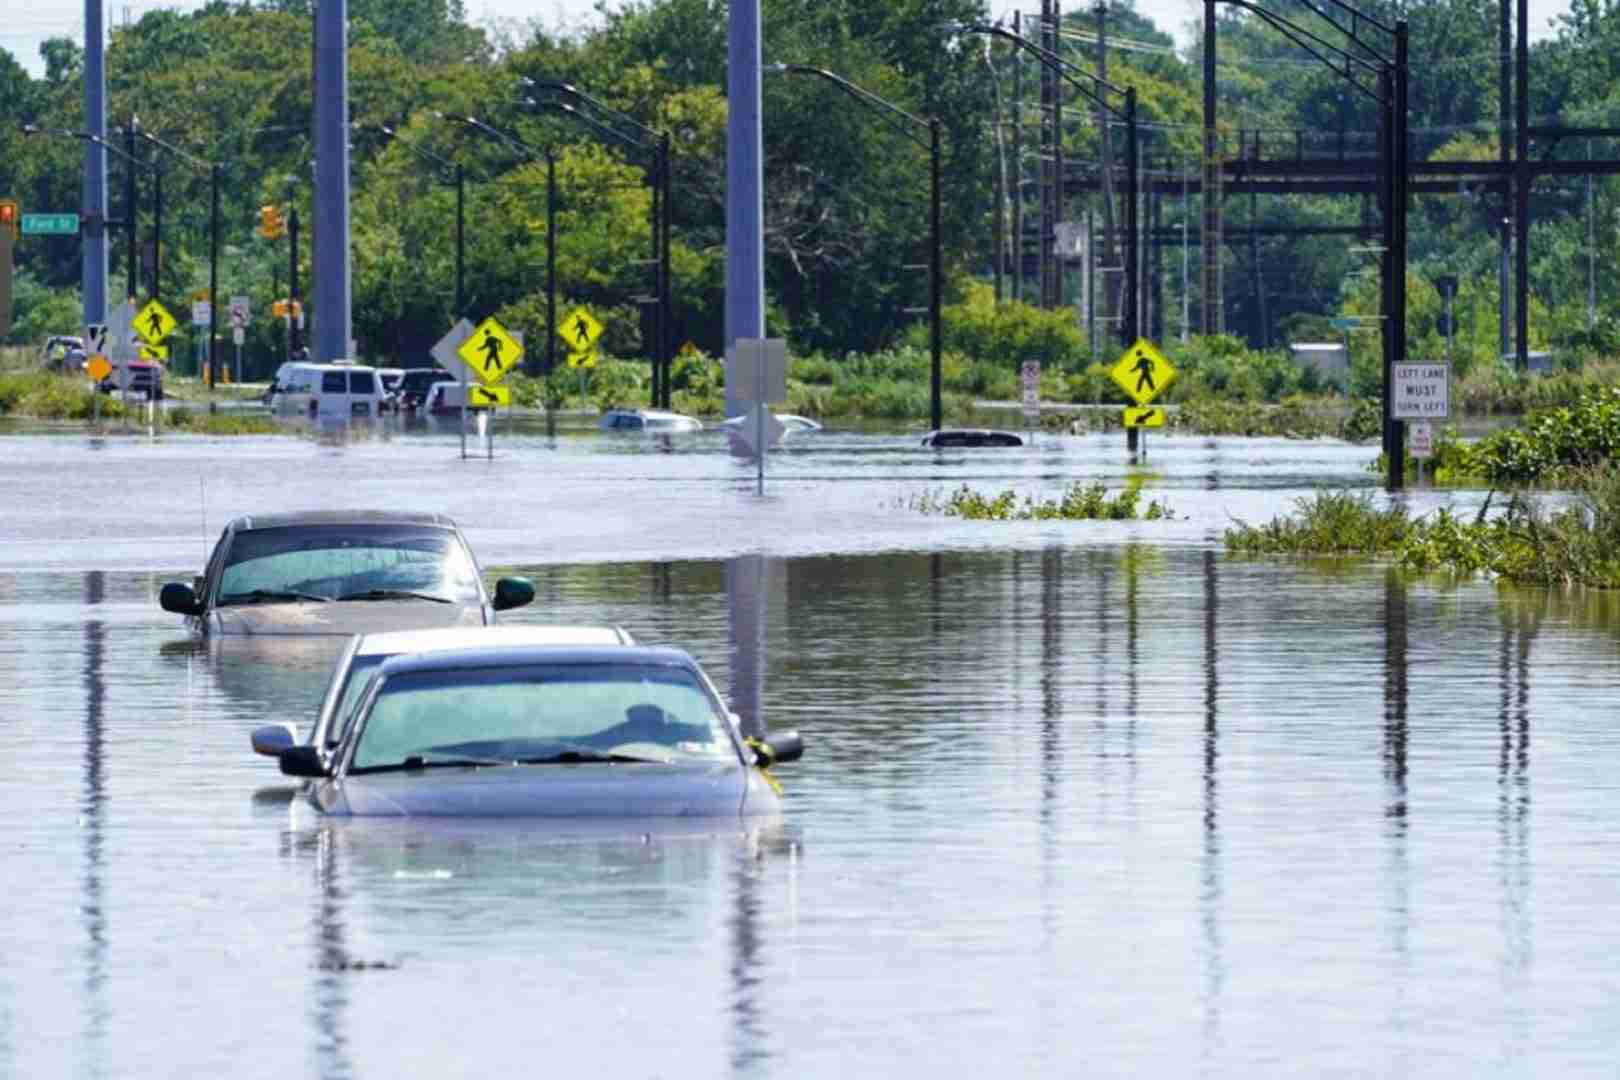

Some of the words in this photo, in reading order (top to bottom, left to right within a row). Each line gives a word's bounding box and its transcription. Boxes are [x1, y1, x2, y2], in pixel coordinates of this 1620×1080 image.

[1397, 368, 1419, 378] LEFT
[1422, 368, 1445, 378] LANE
[1406, 385, 1437, 397] MUST
[1397, 401, 1420, 411] TURN
[1423, 401, 1445, 411] LEFT
